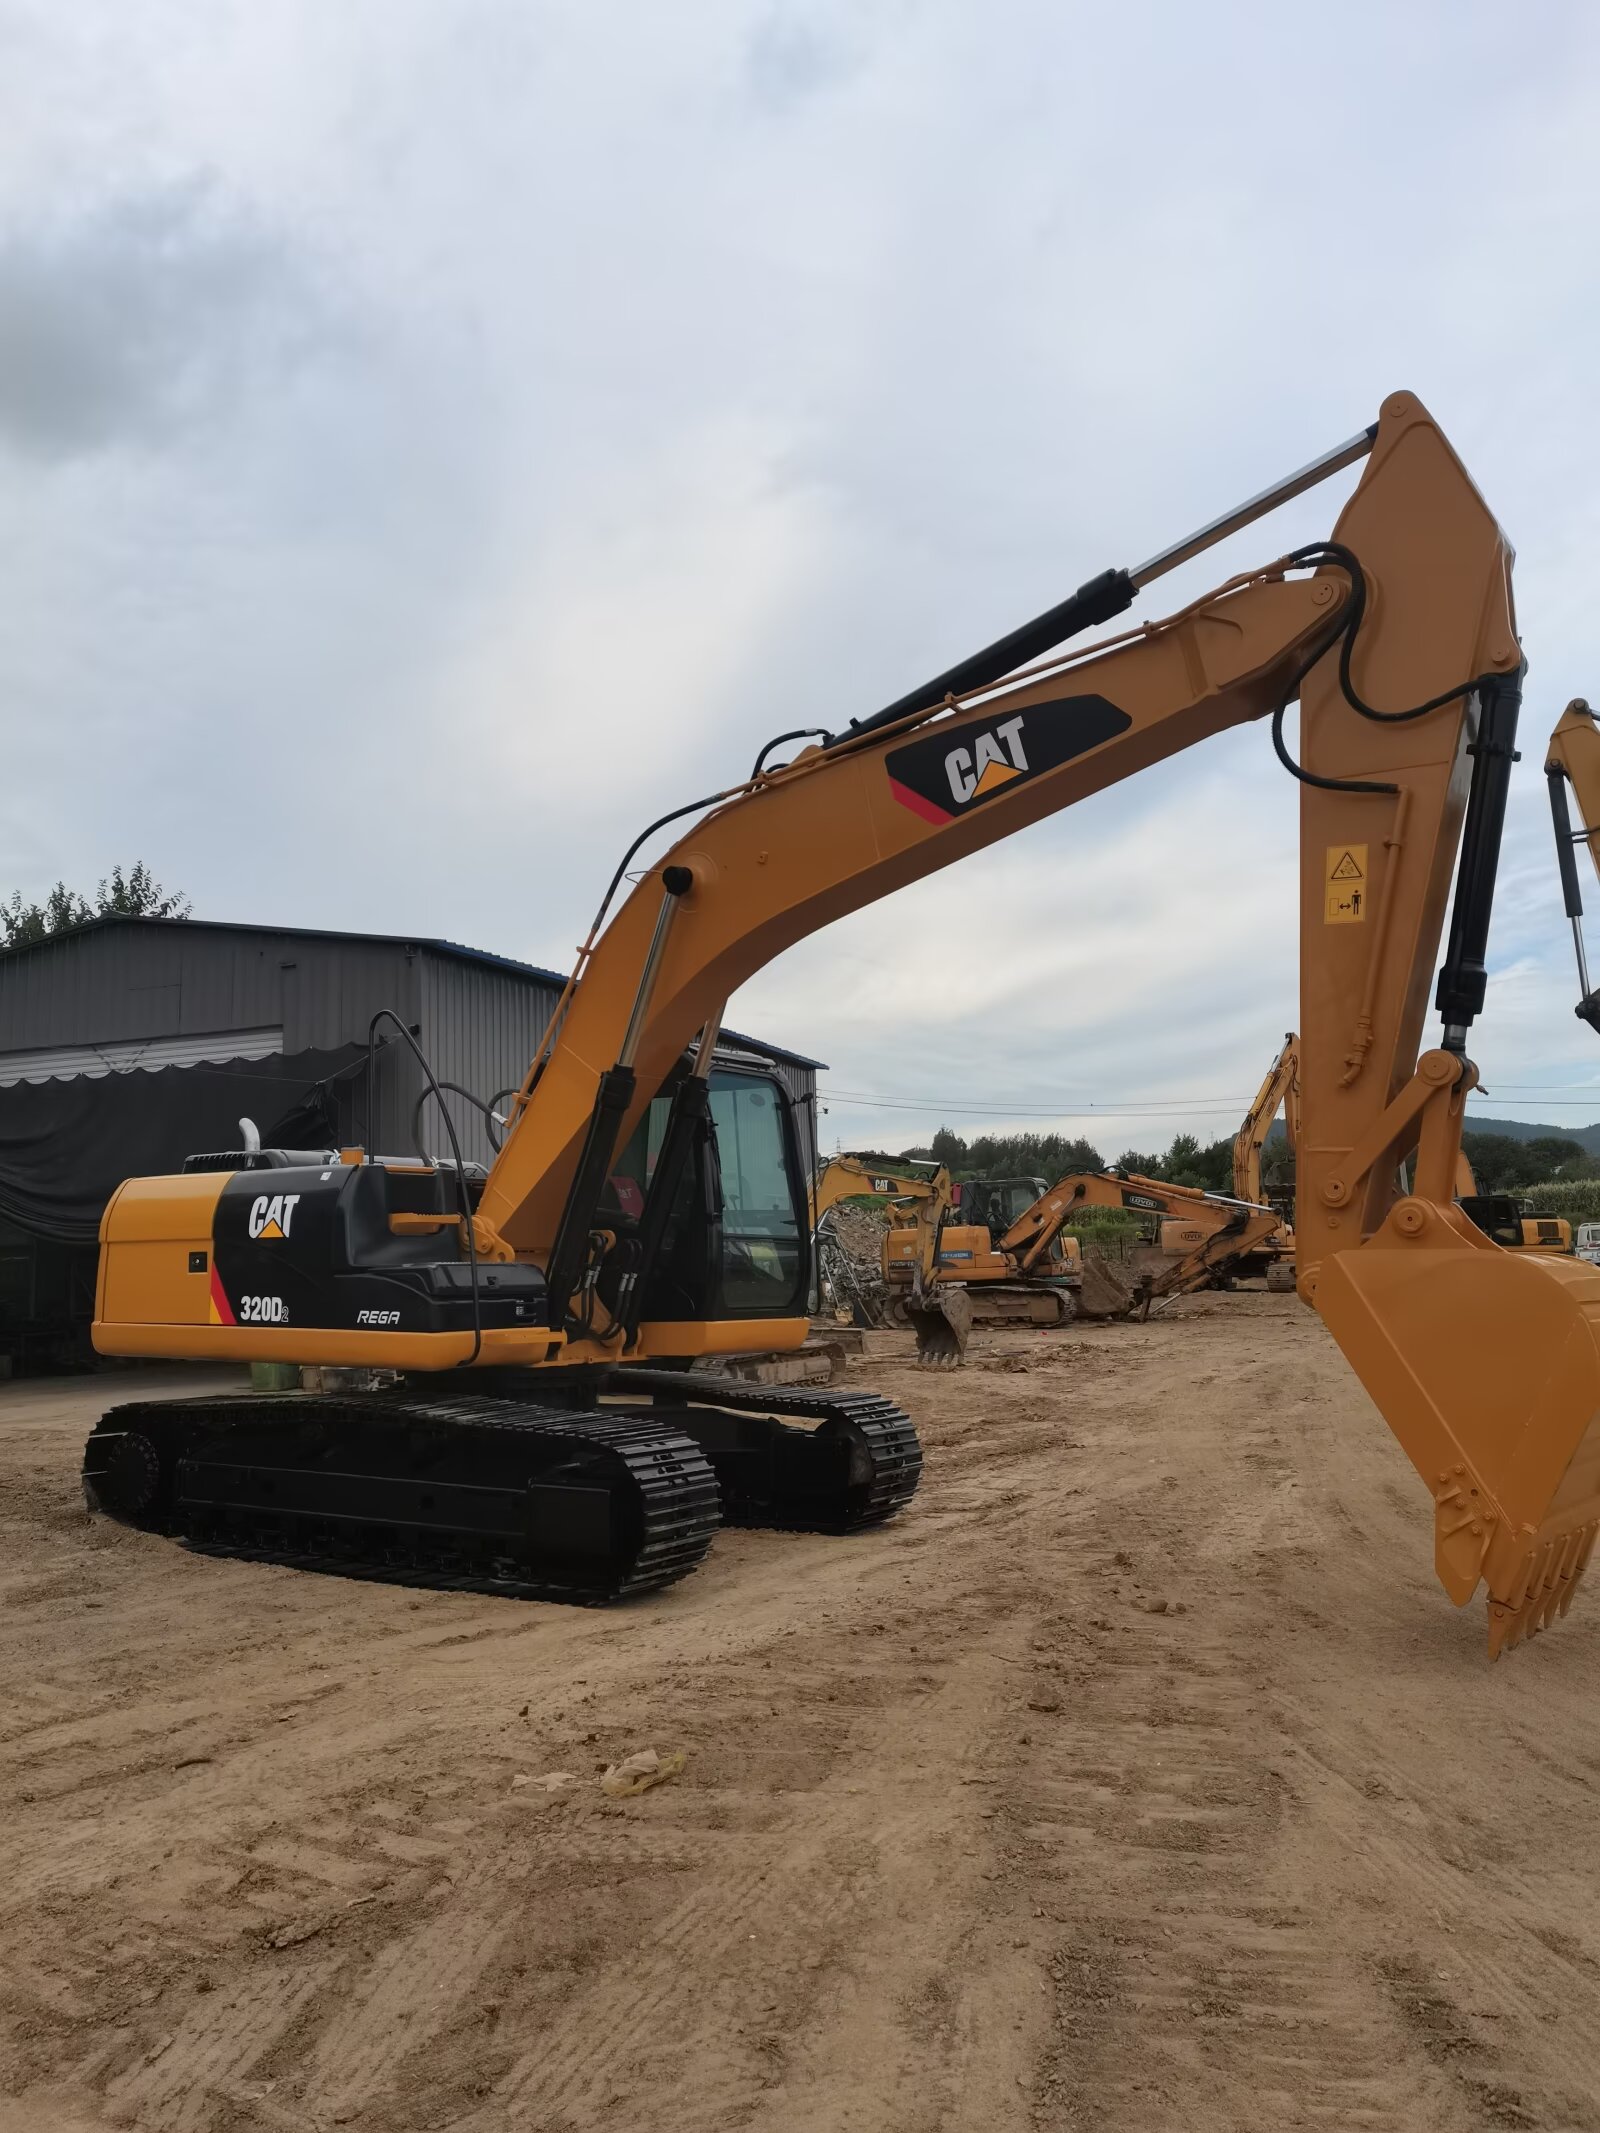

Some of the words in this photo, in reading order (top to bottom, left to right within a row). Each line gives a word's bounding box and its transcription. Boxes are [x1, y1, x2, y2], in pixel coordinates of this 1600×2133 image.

[944, 715, 1029, 804] CAT
[875, 1179, 888, 1192] CAT
[1130, 1196, 1156, 1208] LOVOL
[248, 1194, 300, 1239] CAT
[356, 1310, 401, 1325] REGA
